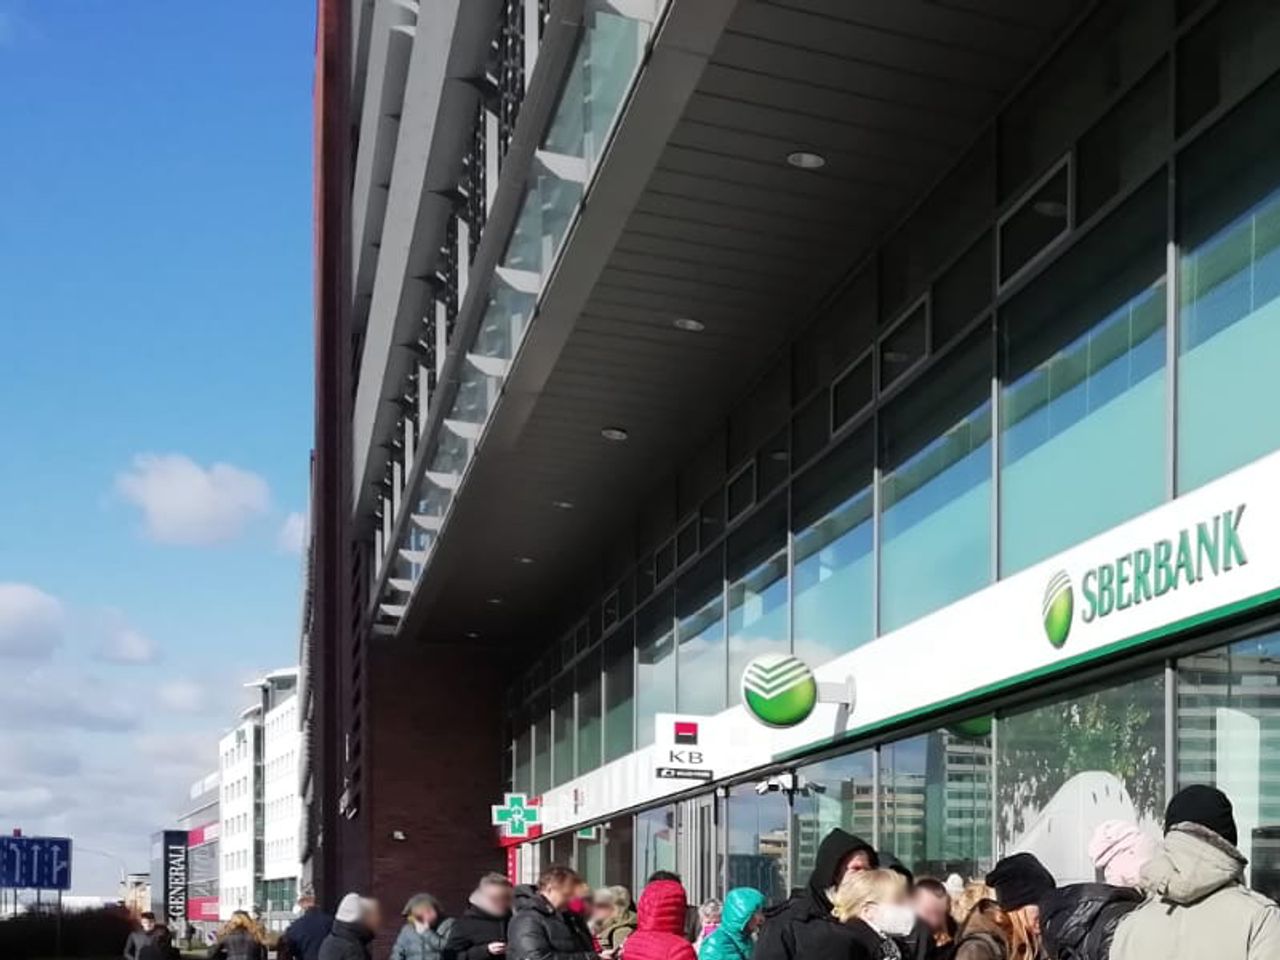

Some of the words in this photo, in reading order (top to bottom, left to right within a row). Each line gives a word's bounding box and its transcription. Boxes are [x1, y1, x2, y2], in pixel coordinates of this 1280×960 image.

[1082, 503, 1247, 623] SBERBANK
[669, 750, 703, 763] KB
[168, 845, 186, 918] GENERALI
